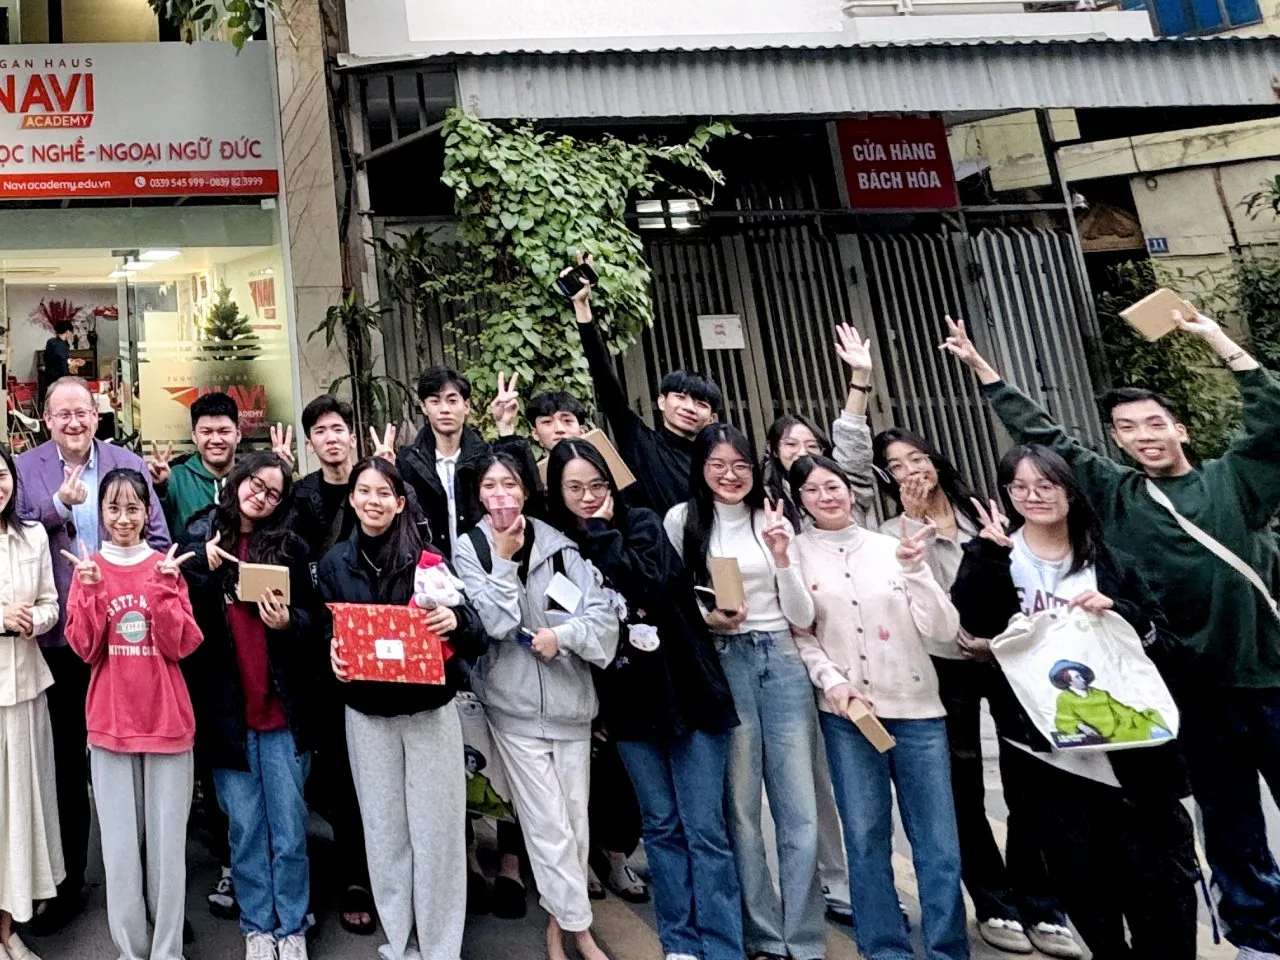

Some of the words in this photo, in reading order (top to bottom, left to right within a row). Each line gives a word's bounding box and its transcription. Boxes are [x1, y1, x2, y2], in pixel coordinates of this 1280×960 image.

[44, 57, 93, 69] HAUS
[25, 115, 89, 127] ACADEMY
[168, 136, 212, 161] NGỮ
[219, 136, 262, 160] ĐỨC
[851, 138, 887, 162] CỬA
[889, 139, 937, 161] HÀNG
[170, 178, 187, 188] 545
[857, 168, 904, 190] BÁCH
[906, 167, 942, 189] HÓA
